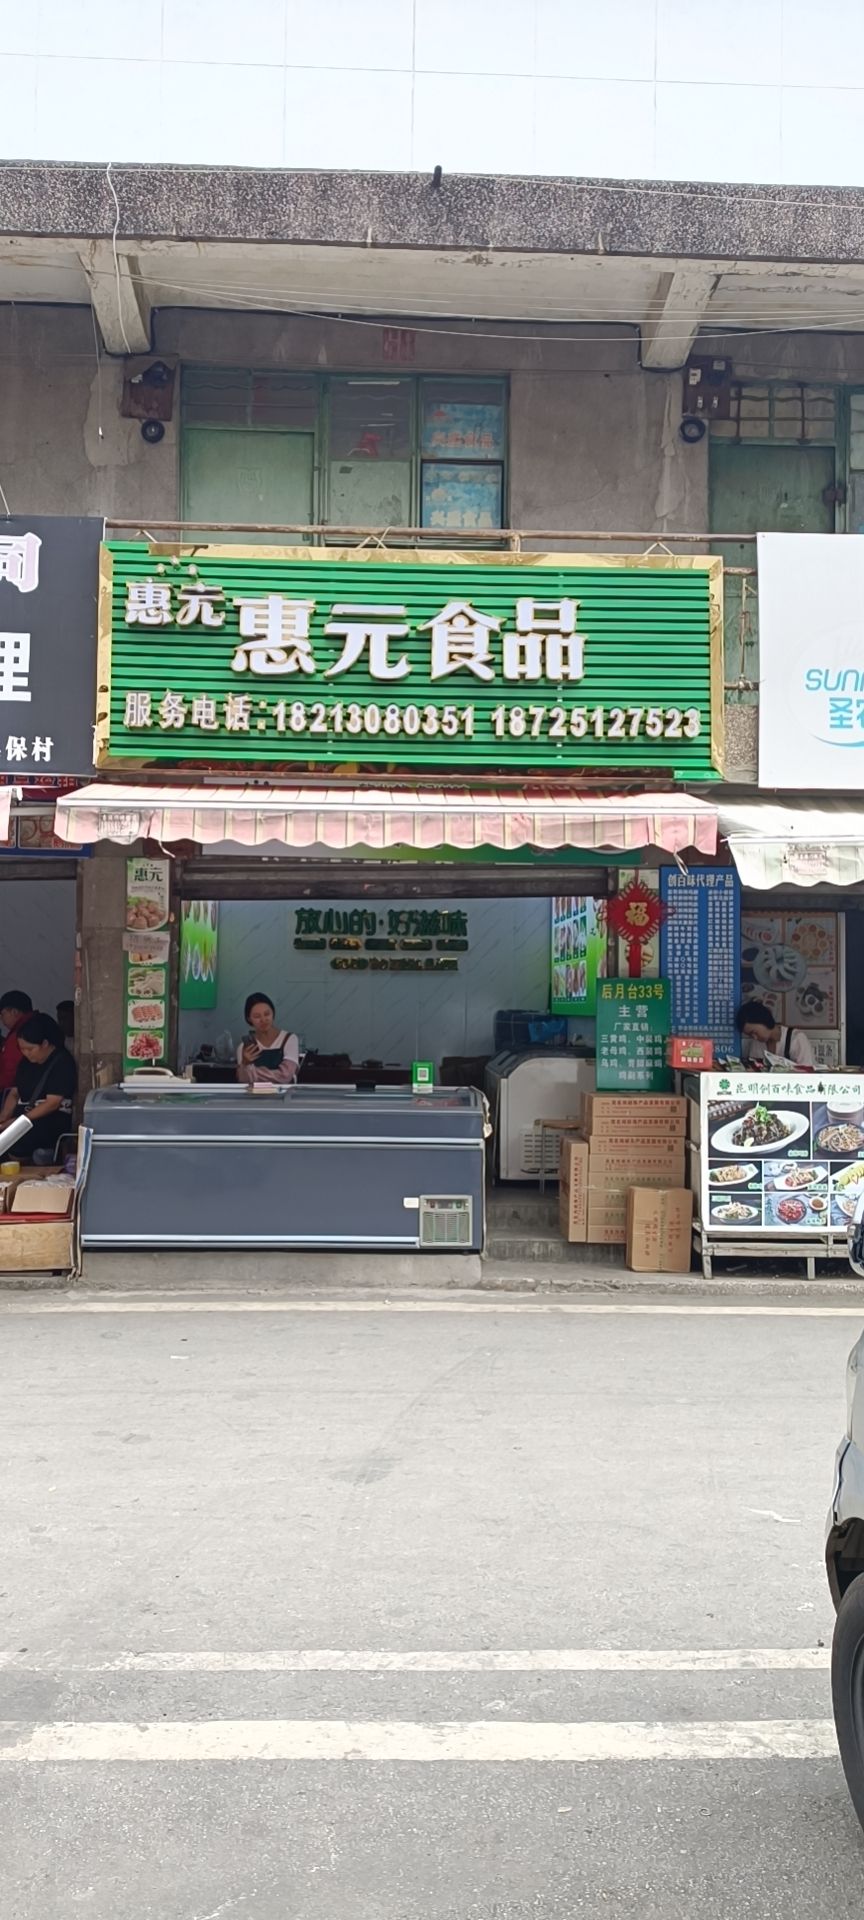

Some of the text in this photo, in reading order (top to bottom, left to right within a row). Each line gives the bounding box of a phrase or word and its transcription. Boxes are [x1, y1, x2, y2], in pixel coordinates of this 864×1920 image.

[125, 577, 227, 628] 惠元
[230, 595, 588, 682] 惠元食品
[805, 668, 864, 692] SUN
[124, 688, 702, 740] 服务电话:18213080351 18725127523
[0, 736, 54, 762] 保村
[134, 866, 164, 882] 惠元
[667, 873, 734, 888] 创百味代理产品
[294, 907, 468, 937] 放心的·好滋味
[624, 901, 650, 927] 福
[602, 983, 665, 1000] 后月台33号
[618, 1004, 649, 1018] 主营
